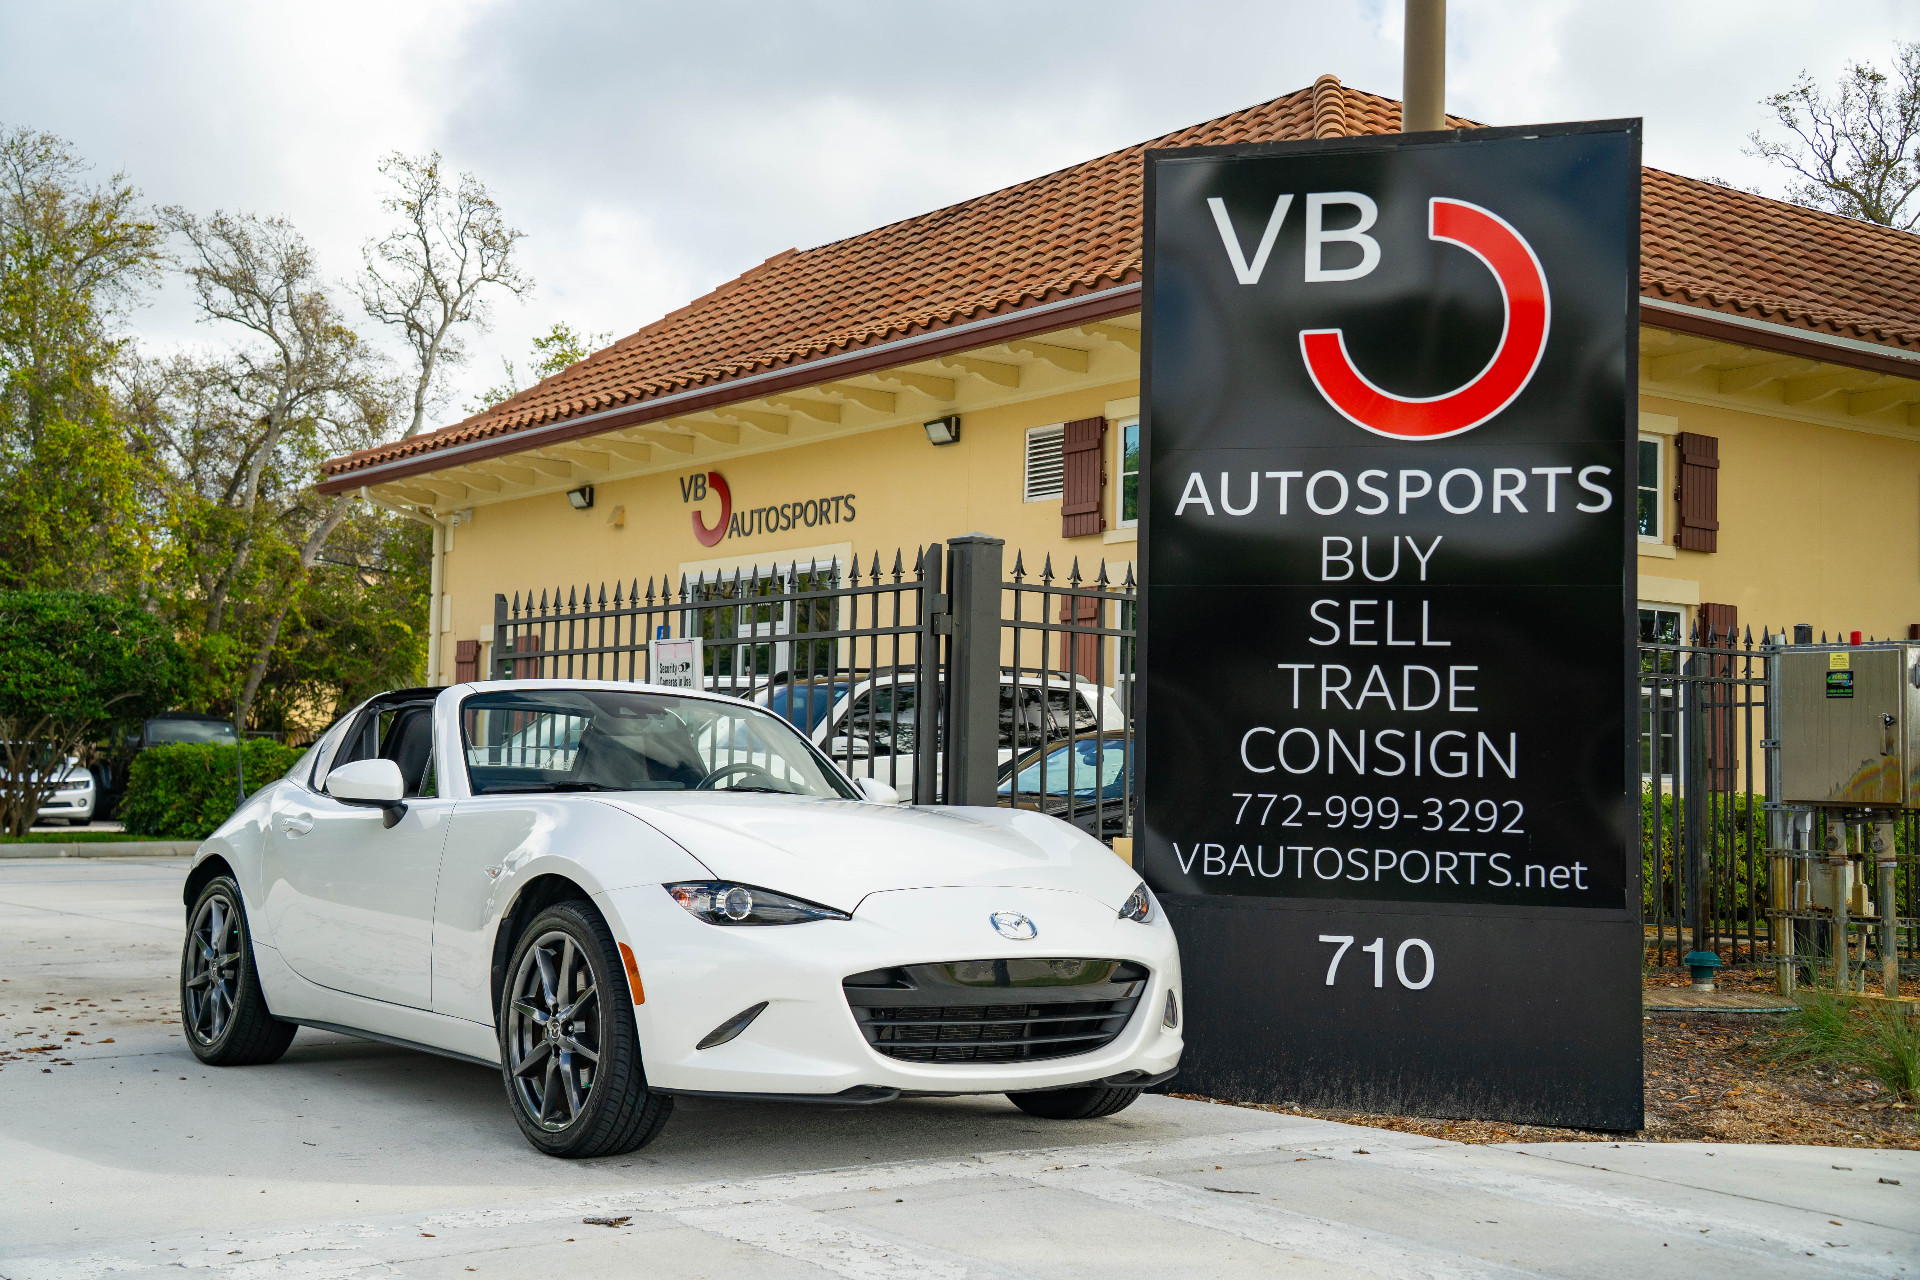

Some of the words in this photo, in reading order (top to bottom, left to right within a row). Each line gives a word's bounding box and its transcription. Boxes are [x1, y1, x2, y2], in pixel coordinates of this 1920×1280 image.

[1206, 191, 1382, 285] VB
[680, 473, 706, 503] VB
[1174, 465, 1613, 517] AUTOSPORTS
[728, 493, 856, 538] AUTOSPORTS
[1321, 535, 1443, 582] BUY
[1308, 599, 1451, 646] SELL
[660, 662, 678, 675] Security
[1277, 663, 1479, 712] TRADE
[1240, 726, 1516, 779] CONSIGN
[1232, 792, 1524, 834] 772-999-3292
[1172, 842, 1589, 890] VBAUTOSPORTS.net
[1318, 934, 1435, 990] 710
